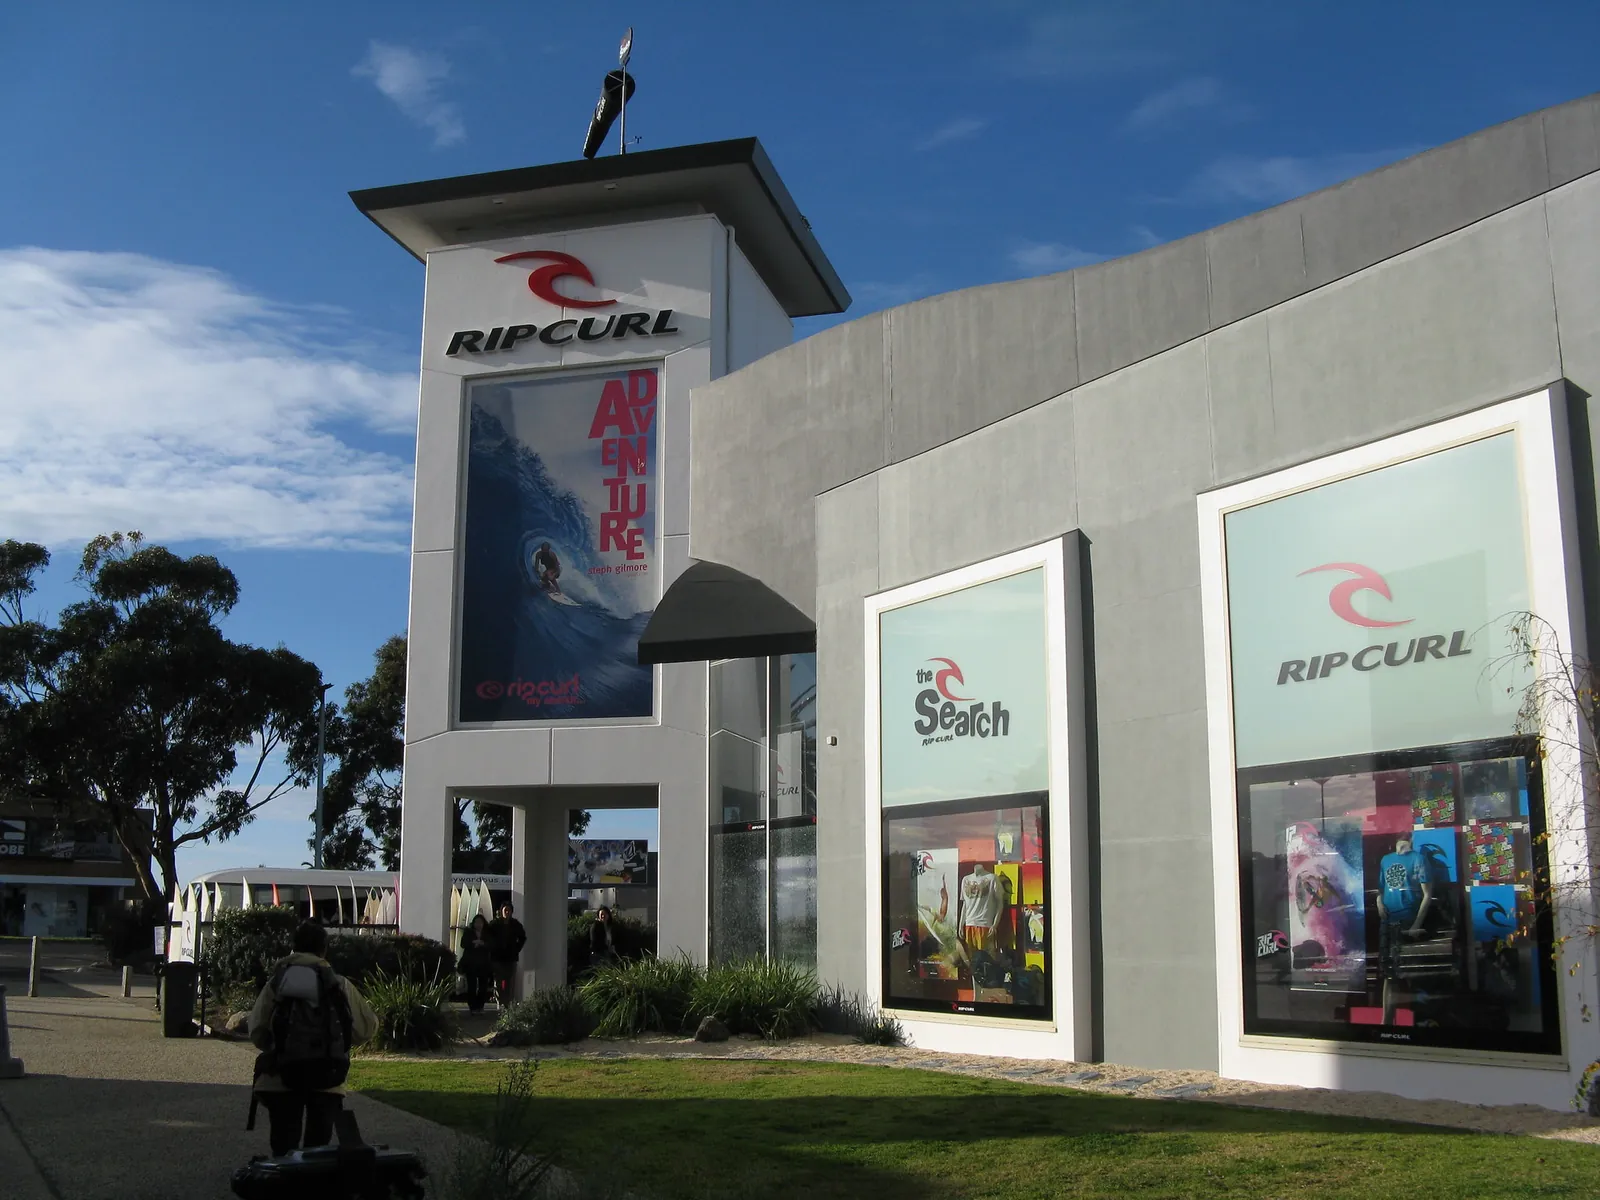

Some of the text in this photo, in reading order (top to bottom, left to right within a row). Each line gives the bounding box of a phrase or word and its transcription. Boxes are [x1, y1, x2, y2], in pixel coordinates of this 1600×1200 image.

[588, 565, 612, 575] steph
[615, 563, 648, 575] gilmore
[916, 669, 933, 684] the
[915, 689, 1009, 738] Search
[1257, 941, 1279, 957] CURL
